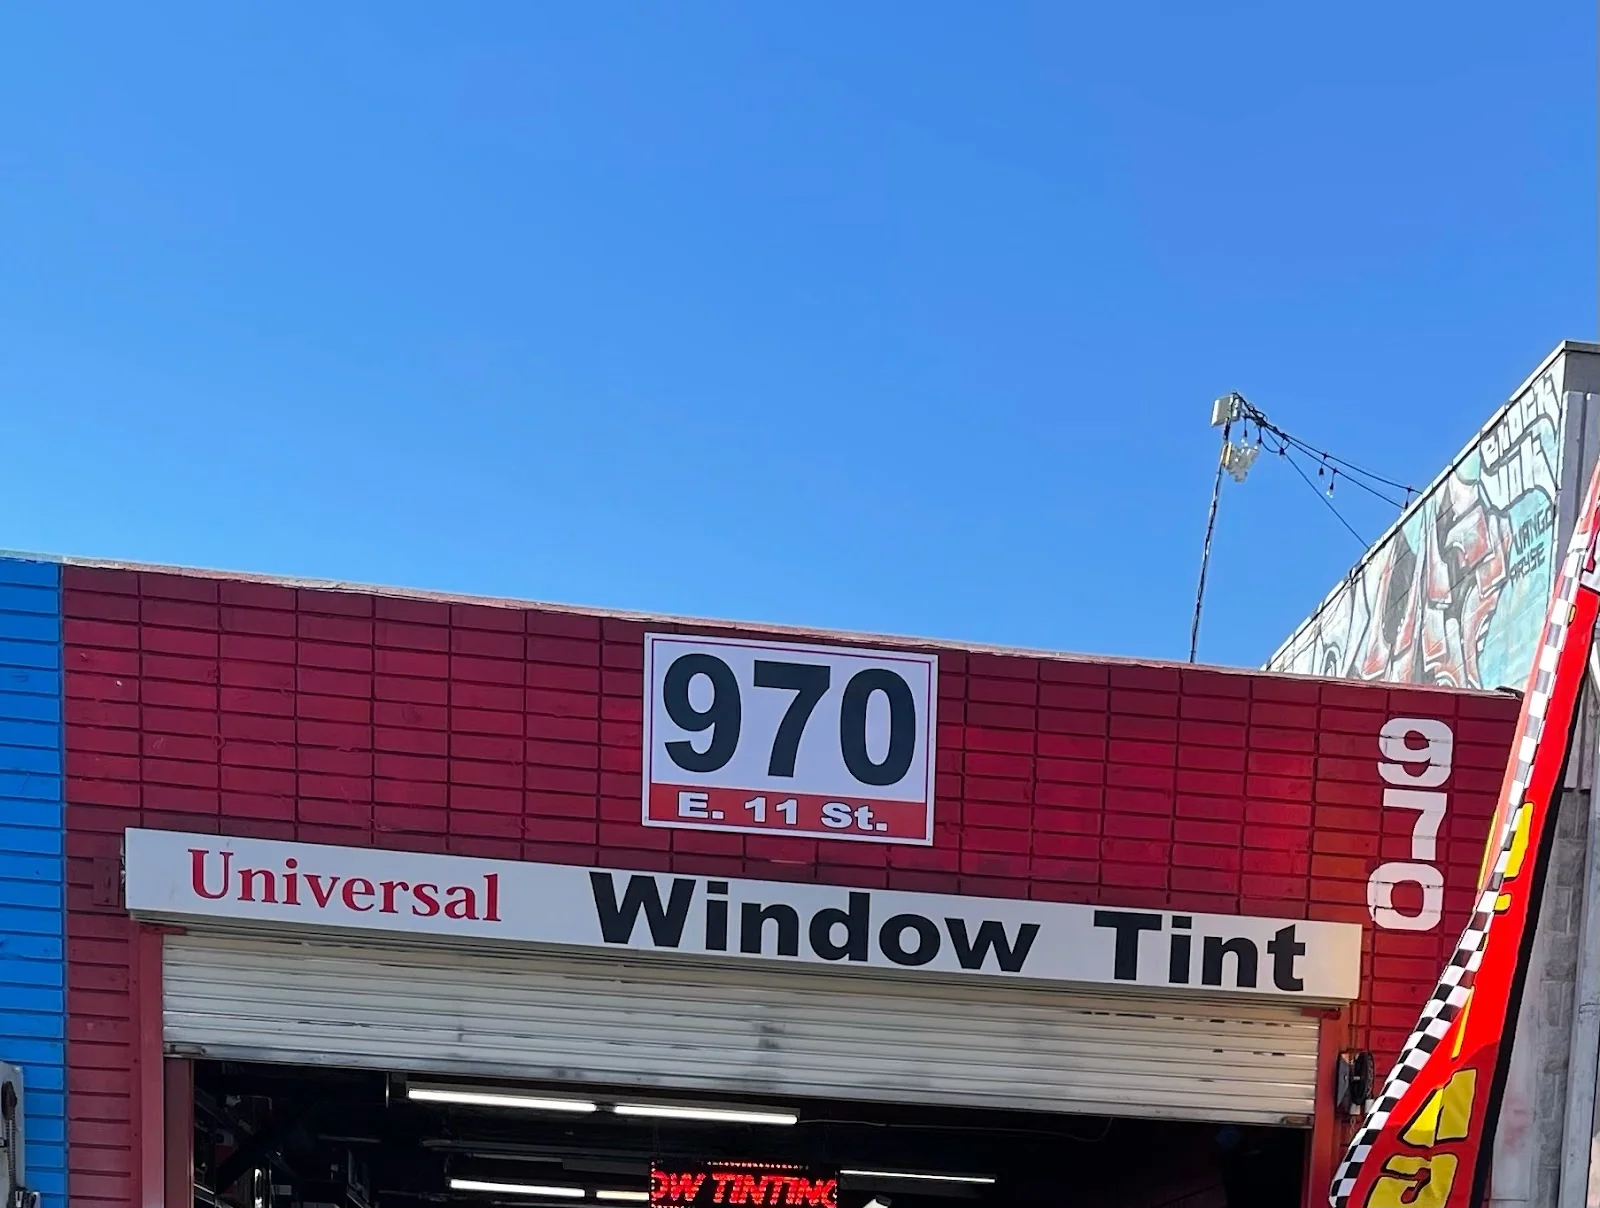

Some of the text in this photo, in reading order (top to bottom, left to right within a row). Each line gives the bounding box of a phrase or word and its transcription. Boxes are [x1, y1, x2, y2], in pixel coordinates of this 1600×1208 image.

[663, 653, 916, 786] 970
[677, 791, 888, 832] E. 11 St.
[1366, 717, 1453, 931] 970
[188, 848, 1305, 992] Universal Window Tint
